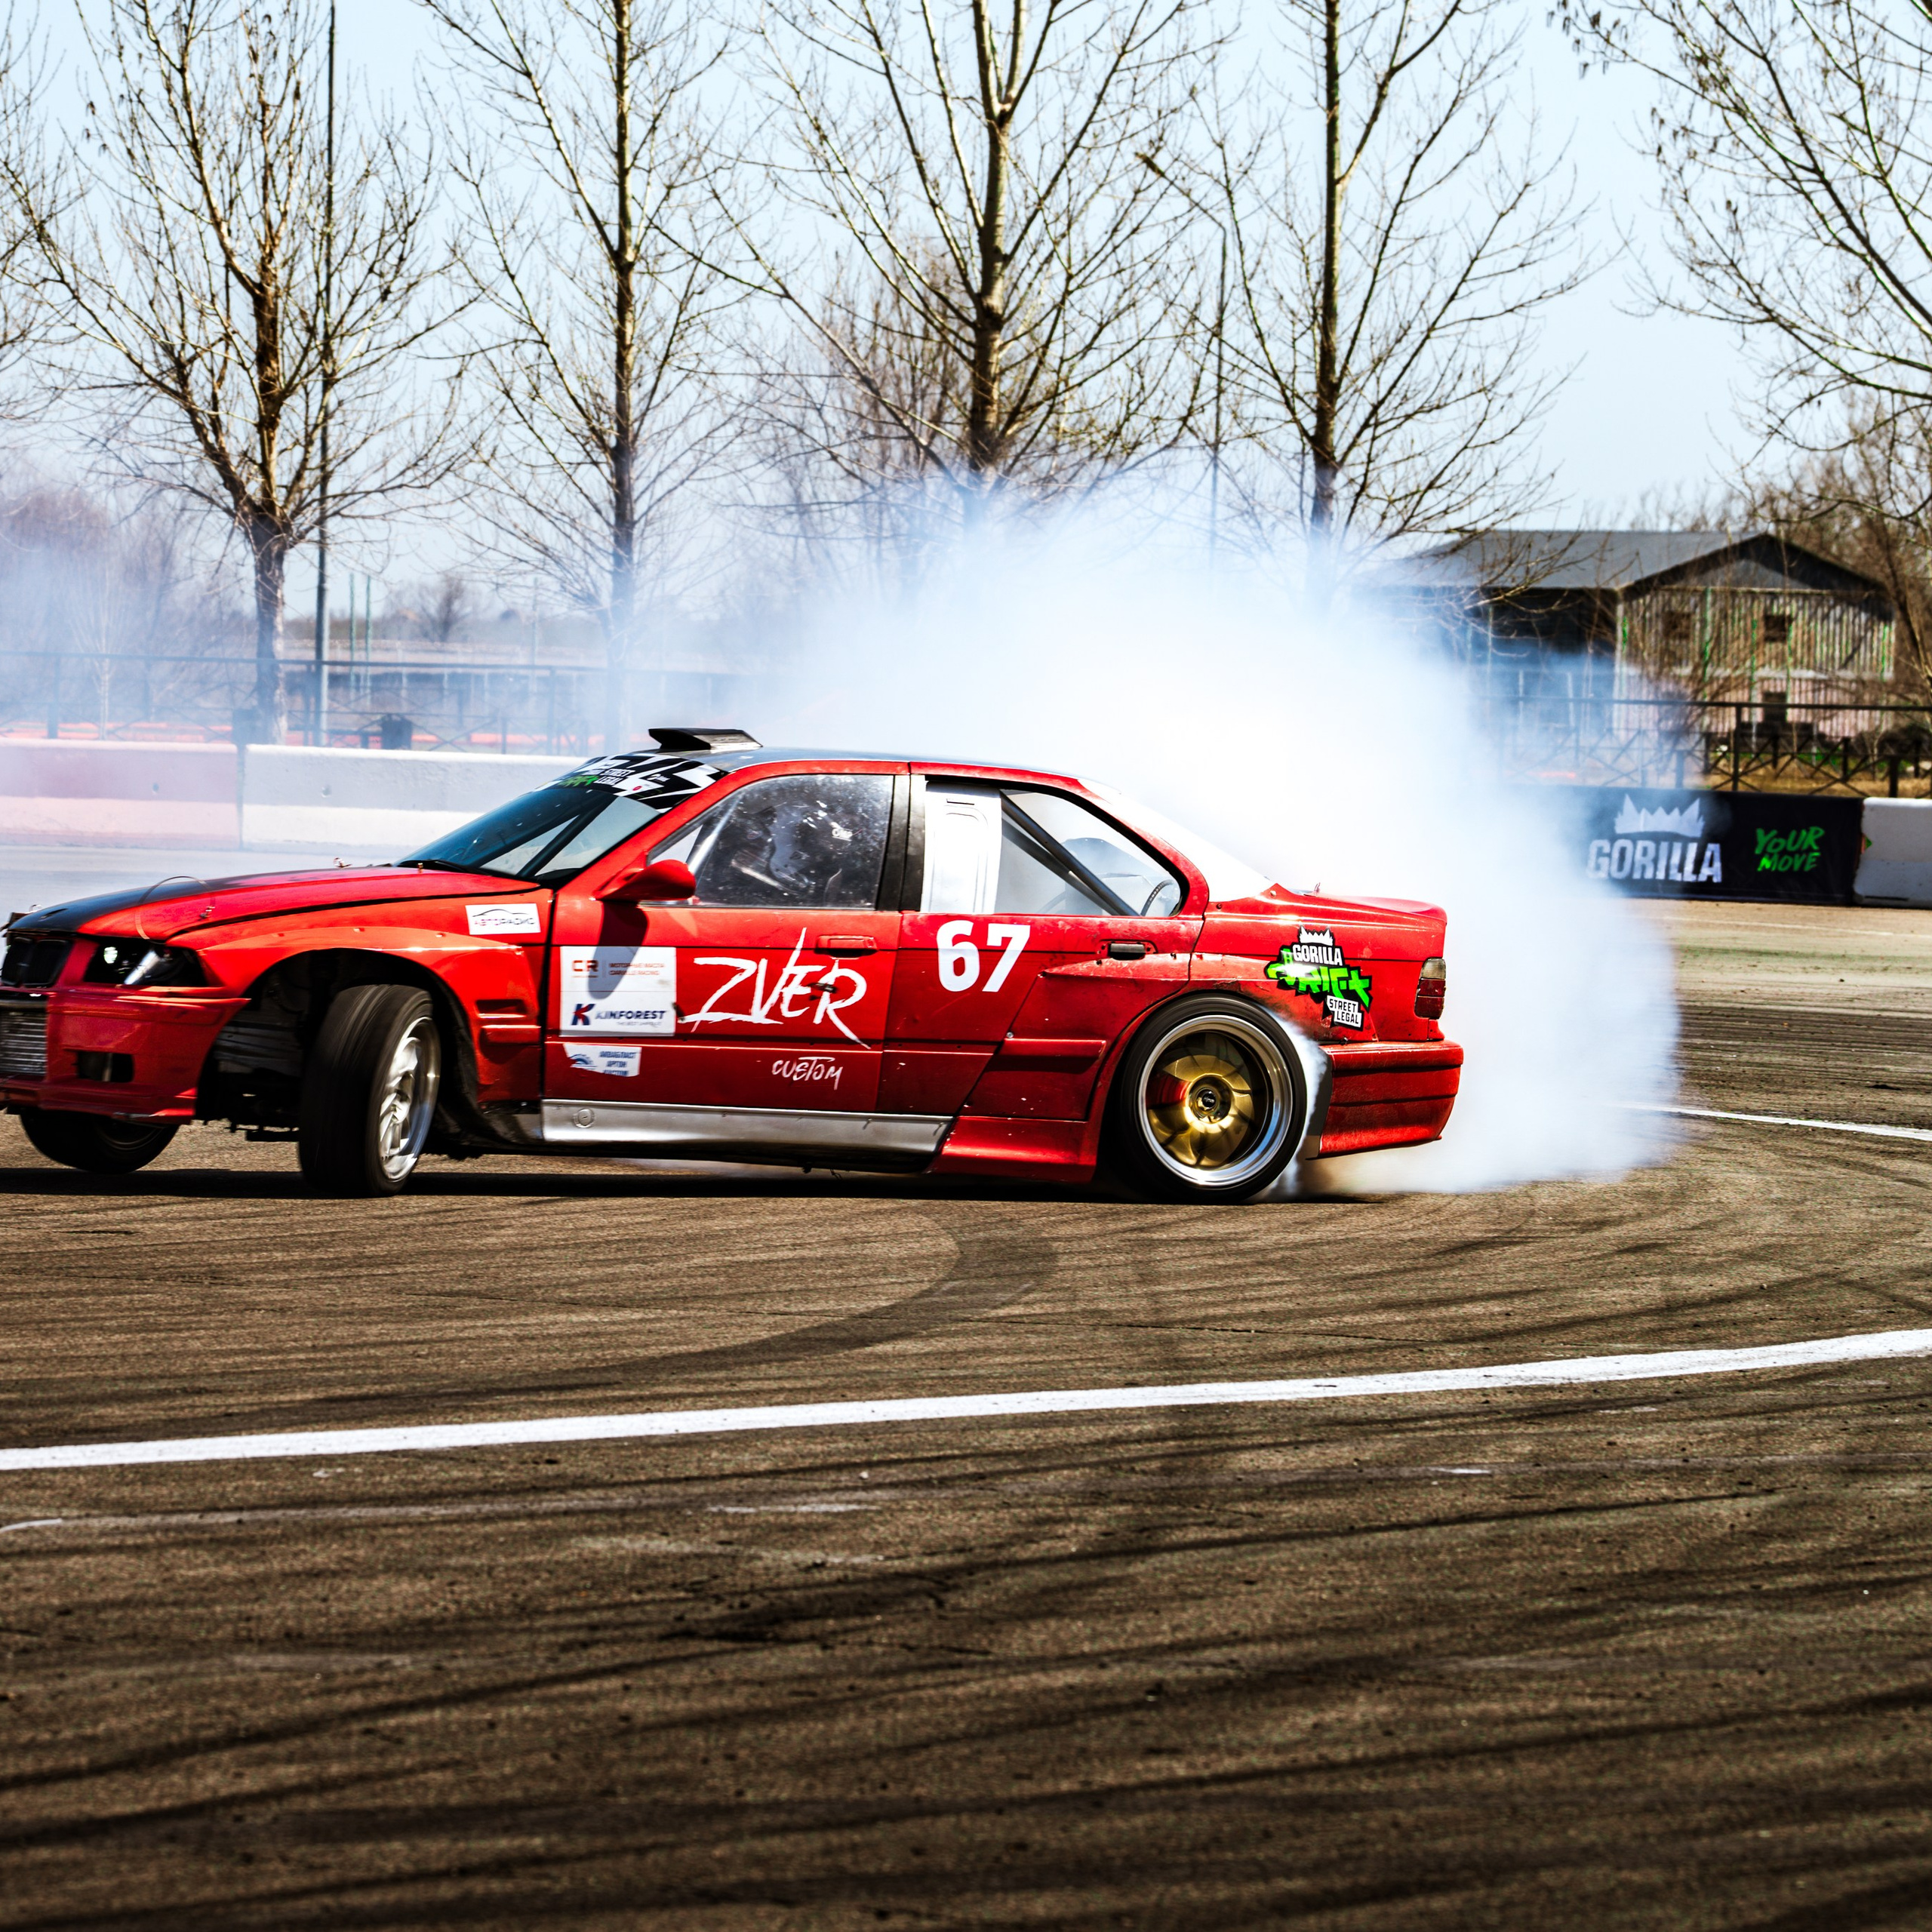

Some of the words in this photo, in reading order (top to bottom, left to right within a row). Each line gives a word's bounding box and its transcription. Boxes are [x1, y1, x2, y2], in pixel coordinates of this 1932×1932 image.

[1755, 826, 1825, 854] YOUR
[1586, 838, 1722, 883] GORILLA
[1757, 851, 1820, 872] MOVE
[571, 959, 598, 972] CR
[936, 919, 1030, 992] 67
[1292, 944, 1343, 967] GORILLA
[678, 927, 871, 1050] ZVER
[1329, 998, 1357, 1012] STREET
[1337, 1011, 1359, 1025] LEGAL
[771, 1057, 844, 1091] CUSTOM
